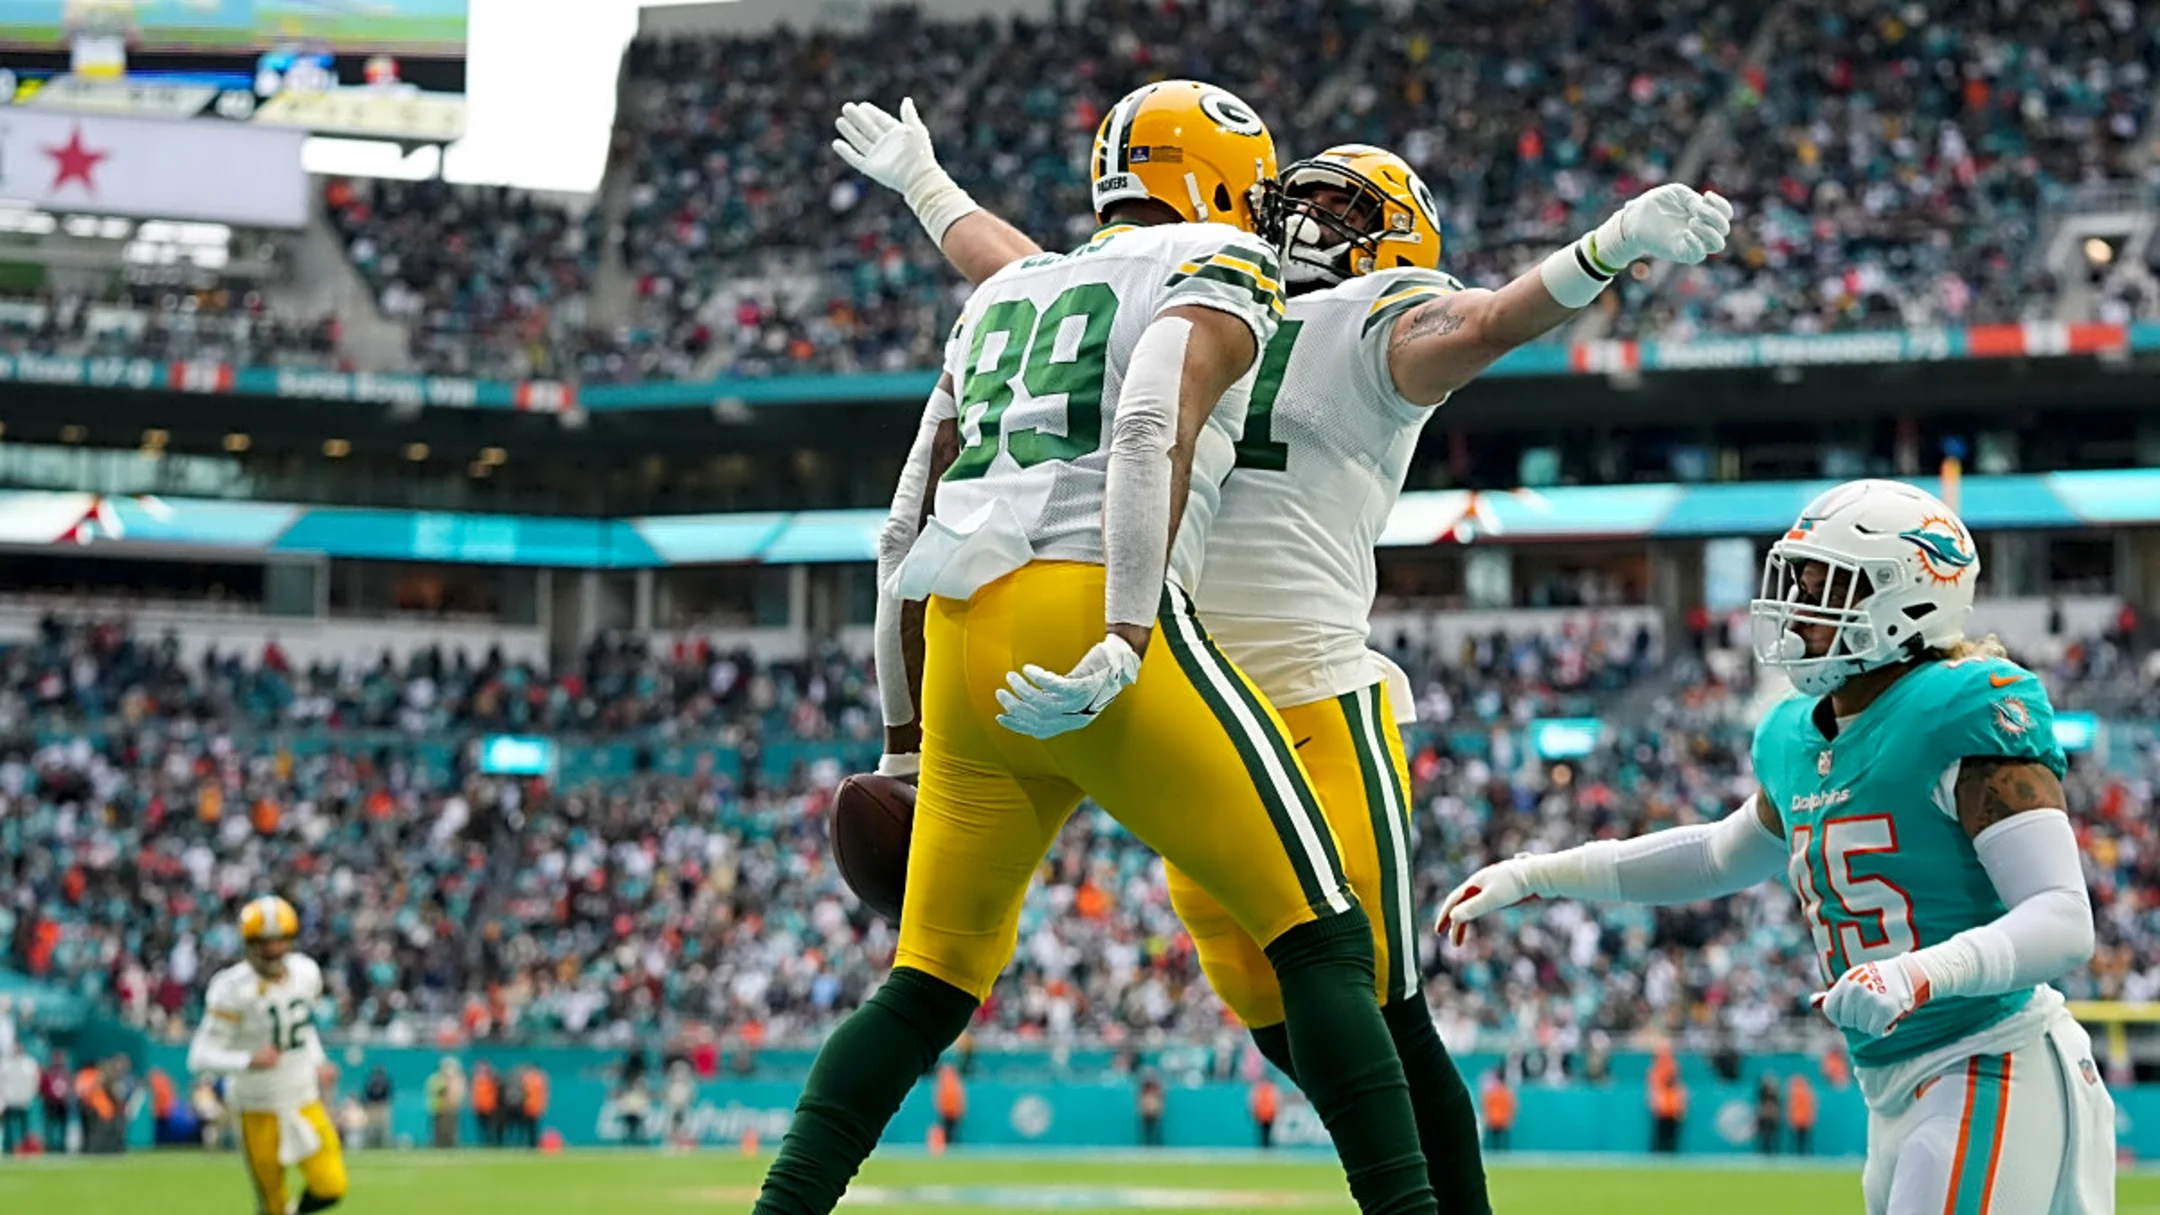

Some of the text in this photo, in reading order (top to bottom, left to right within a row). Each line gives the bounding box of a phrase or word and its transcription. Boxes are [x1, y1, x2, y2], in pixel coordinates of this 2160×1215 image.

[941, 282, 1120, 481] 89
[1792, 788, 1852, 814] Dolphins
[1789, 812, 1920, 990] 45
[268, 997, 315, 1050] 12
